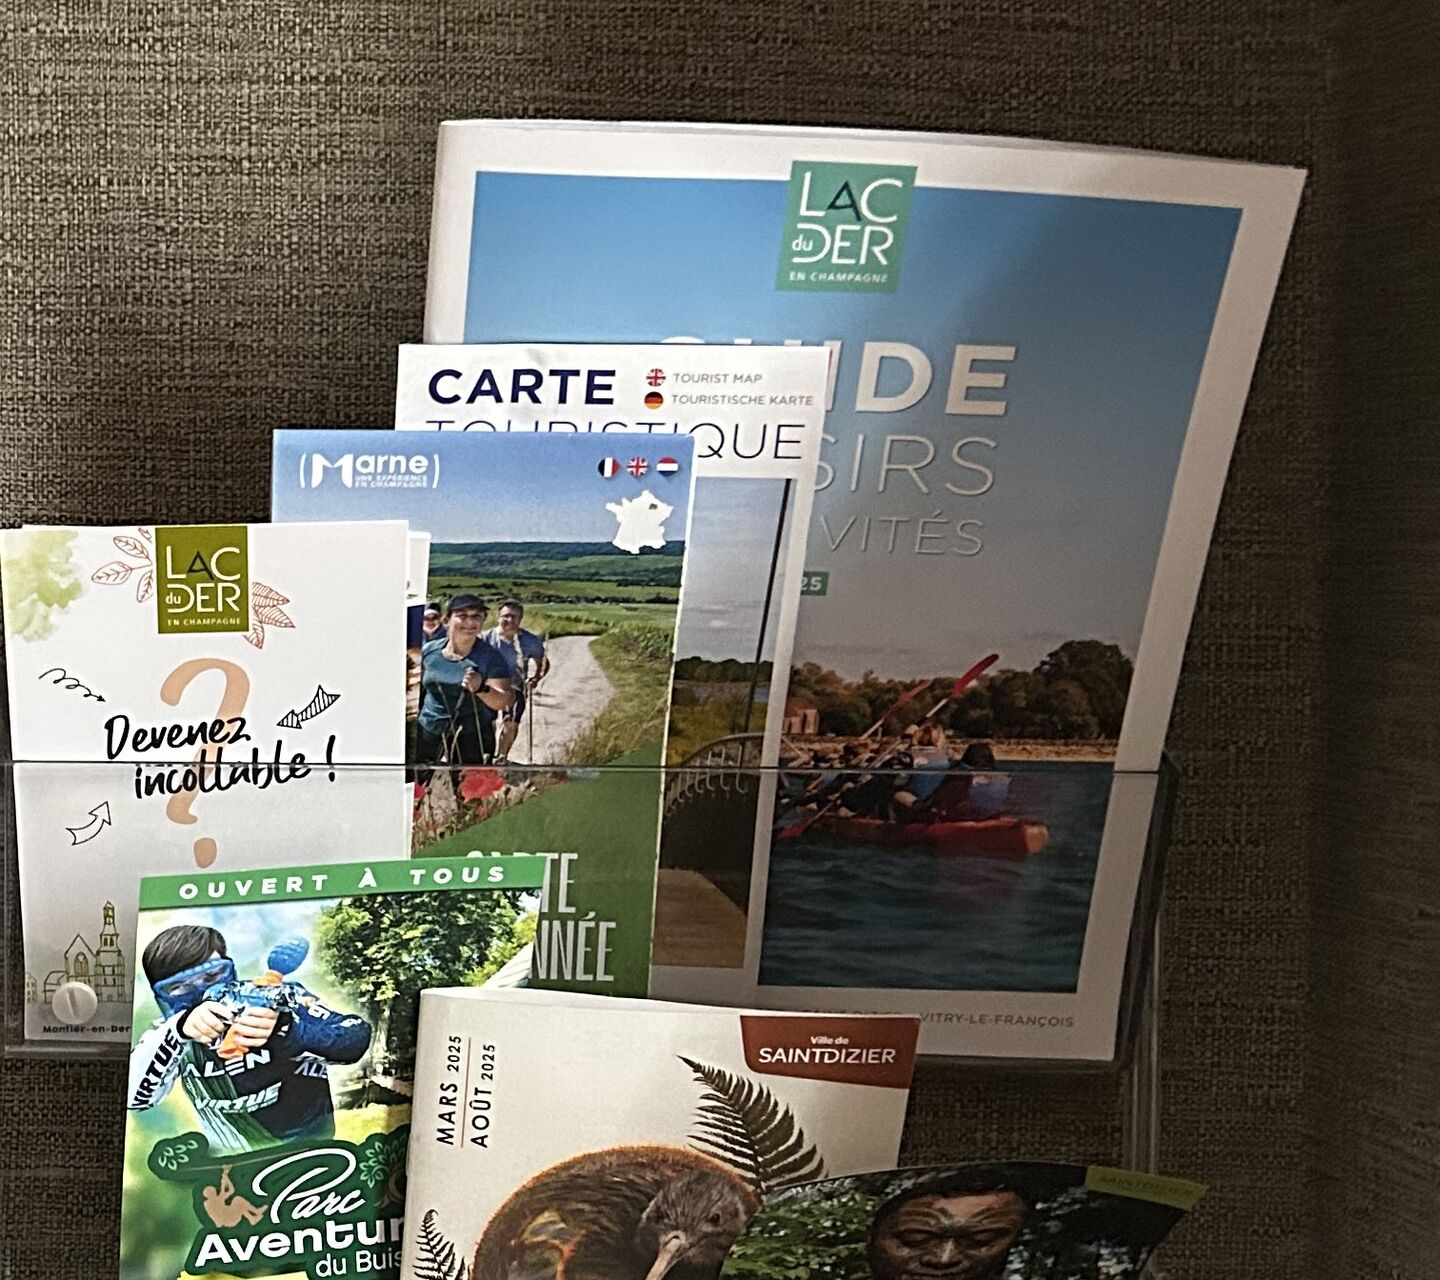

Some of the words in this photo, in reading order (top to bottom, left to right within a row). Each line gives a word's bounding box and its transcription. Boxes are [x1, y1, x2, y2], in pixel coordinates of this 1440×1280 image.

[799, 171, 904, 223] LAC
[792, 223, 894, 266] DER
[789, 272, 806, 282] EN
[810, 272, 889, 283] CHAMPAGNE
[428, 368, 616, 407] CARTE
[672, 373, 729, 384] TOURIST
[732, 373, 763, 384] MAP
[671, 394, 765, 406] TOURISTISCHE
[769, 395, 814, 407] KARTE
[166, 546, 241, 581] LAC
[166, 582, 241, 614] DER
[167, 617, 181, 627] EN
[185, 616, 241, 627] CHAMPAGNE
[103, 713, 252, 760] Devenez
[134, 748, 312, 801] incollable
[178, 873, 329, 900] OUVERT
[359, 865, 378, 889] À
[410, 865, 506, 886] TOUS
[446, 1034, 462, 1073] 2025
[810, 1035, 834, 1045] Ville
[835, 1035, 849, 1045] de
[131, 1028, 179, 1109] VIRTUE
[480, 1043, 496, 1082] 2025
[437, 1079, 461, 1147] MARS
[470, 1086, 493, 1149] AOÛT
[252, 1148, 368, 1224] Parc
[316, 1253, 348, 1278] du
